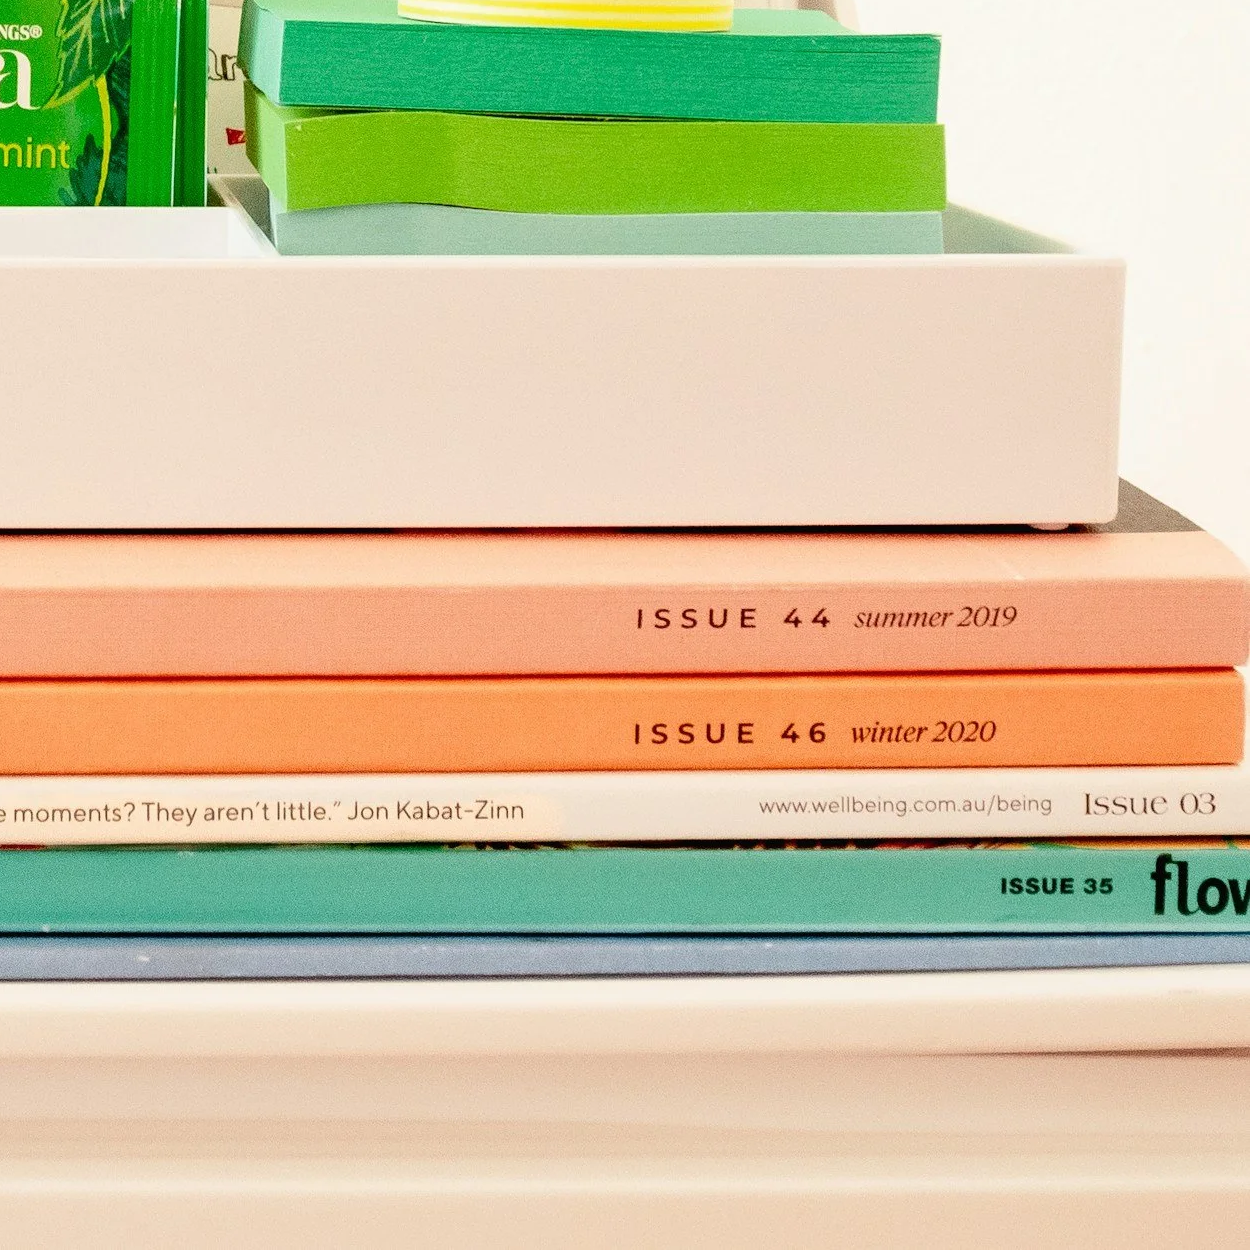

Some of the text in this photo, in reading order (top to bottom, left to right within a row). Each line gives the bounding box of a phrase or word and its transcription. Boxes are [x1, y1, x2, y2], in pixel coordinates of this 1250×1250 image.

[637, 605, 1018, 629] ISSUE 44 summer 2019
[634, 720, 996, 744] ISSUE 46 winter 2020
[13, 803, 136, 823] moments?
[141, 802, 196, 827] They
[203, 801, 270, 822] aren't
[348, 801, 388, 821] Jon
[397, 800, 524, 820] Kabat-Zinn
[759, 795, 1052, 818] www.wellbeing.com.au/being
[1084, 792, 1217, 815] Issue 03
[1001, 877, 1114, 895] ISSUE 35
